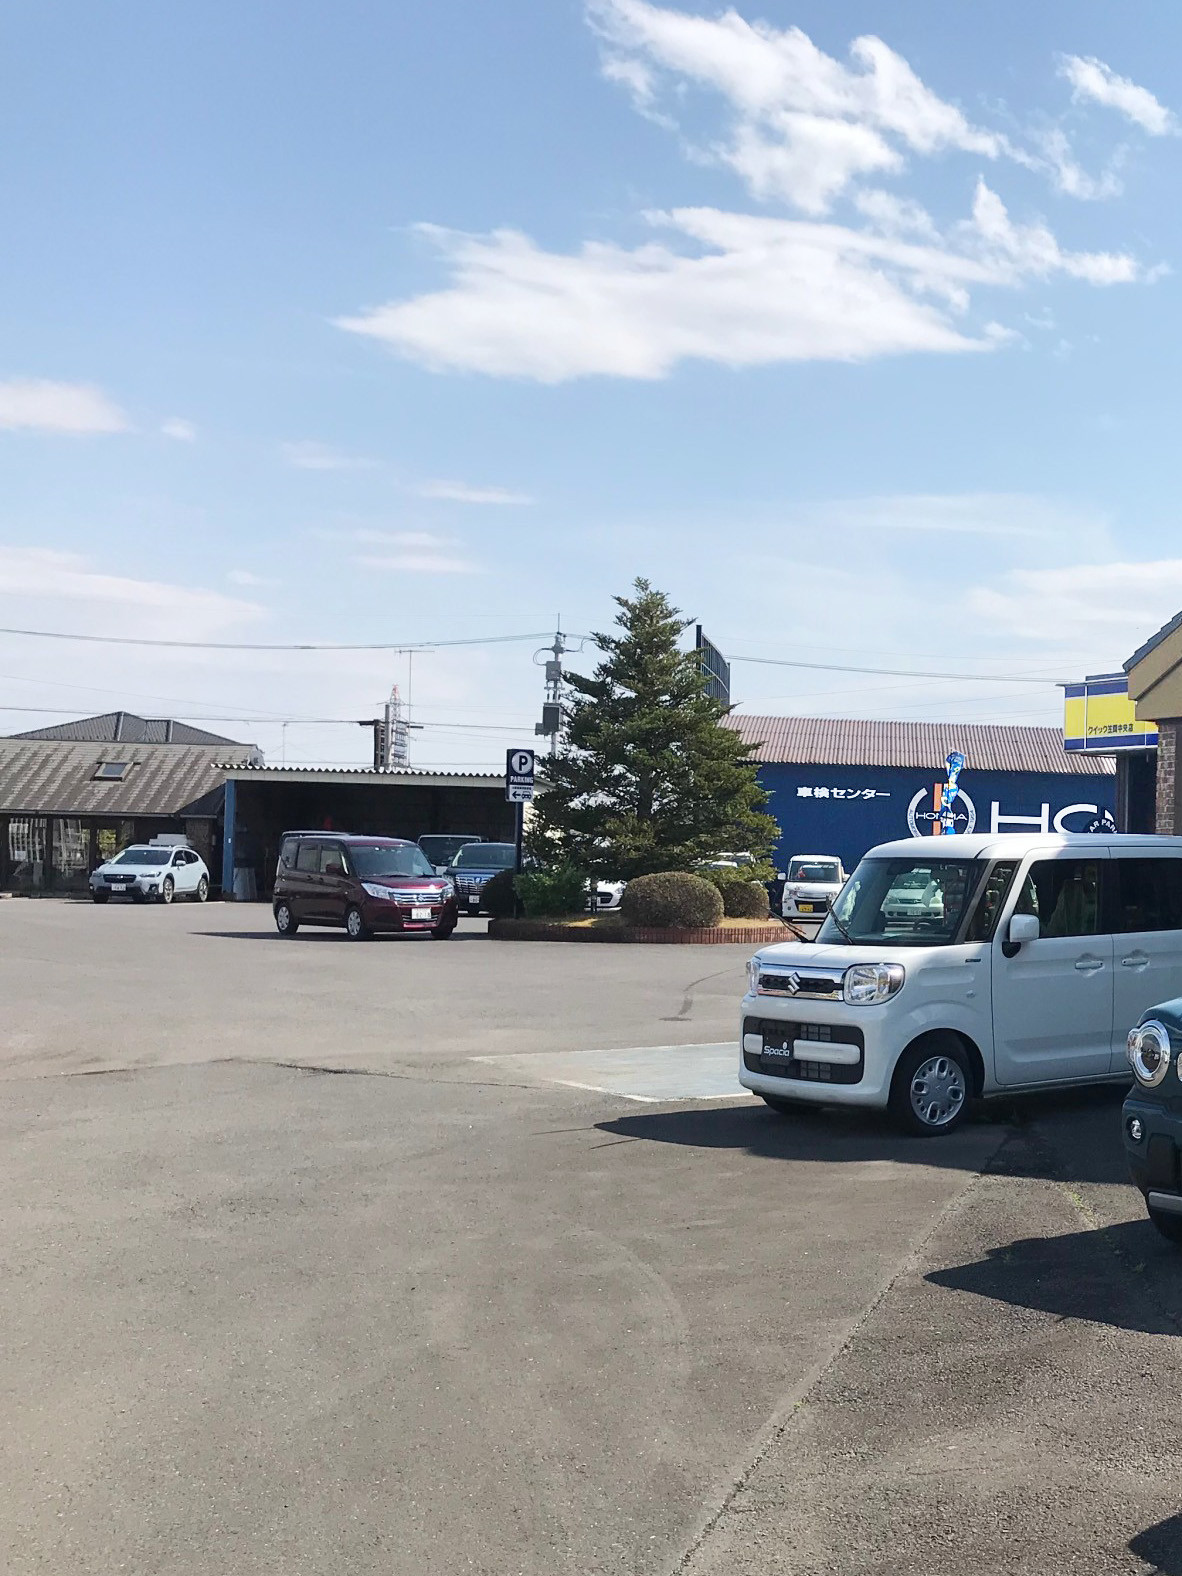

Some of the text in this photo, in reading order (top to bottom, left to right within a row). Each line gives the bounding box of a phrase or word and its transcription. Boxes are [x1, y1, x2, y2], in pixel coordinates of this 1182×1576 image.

[518, 754, 529, 771] P
[510, 775, 534, 784] PARKING
[796, 786, 891, 800] 車検センター
[1101, 819, 1118, 833] PAR
[763, 1042, 790, 1057] Spacia
